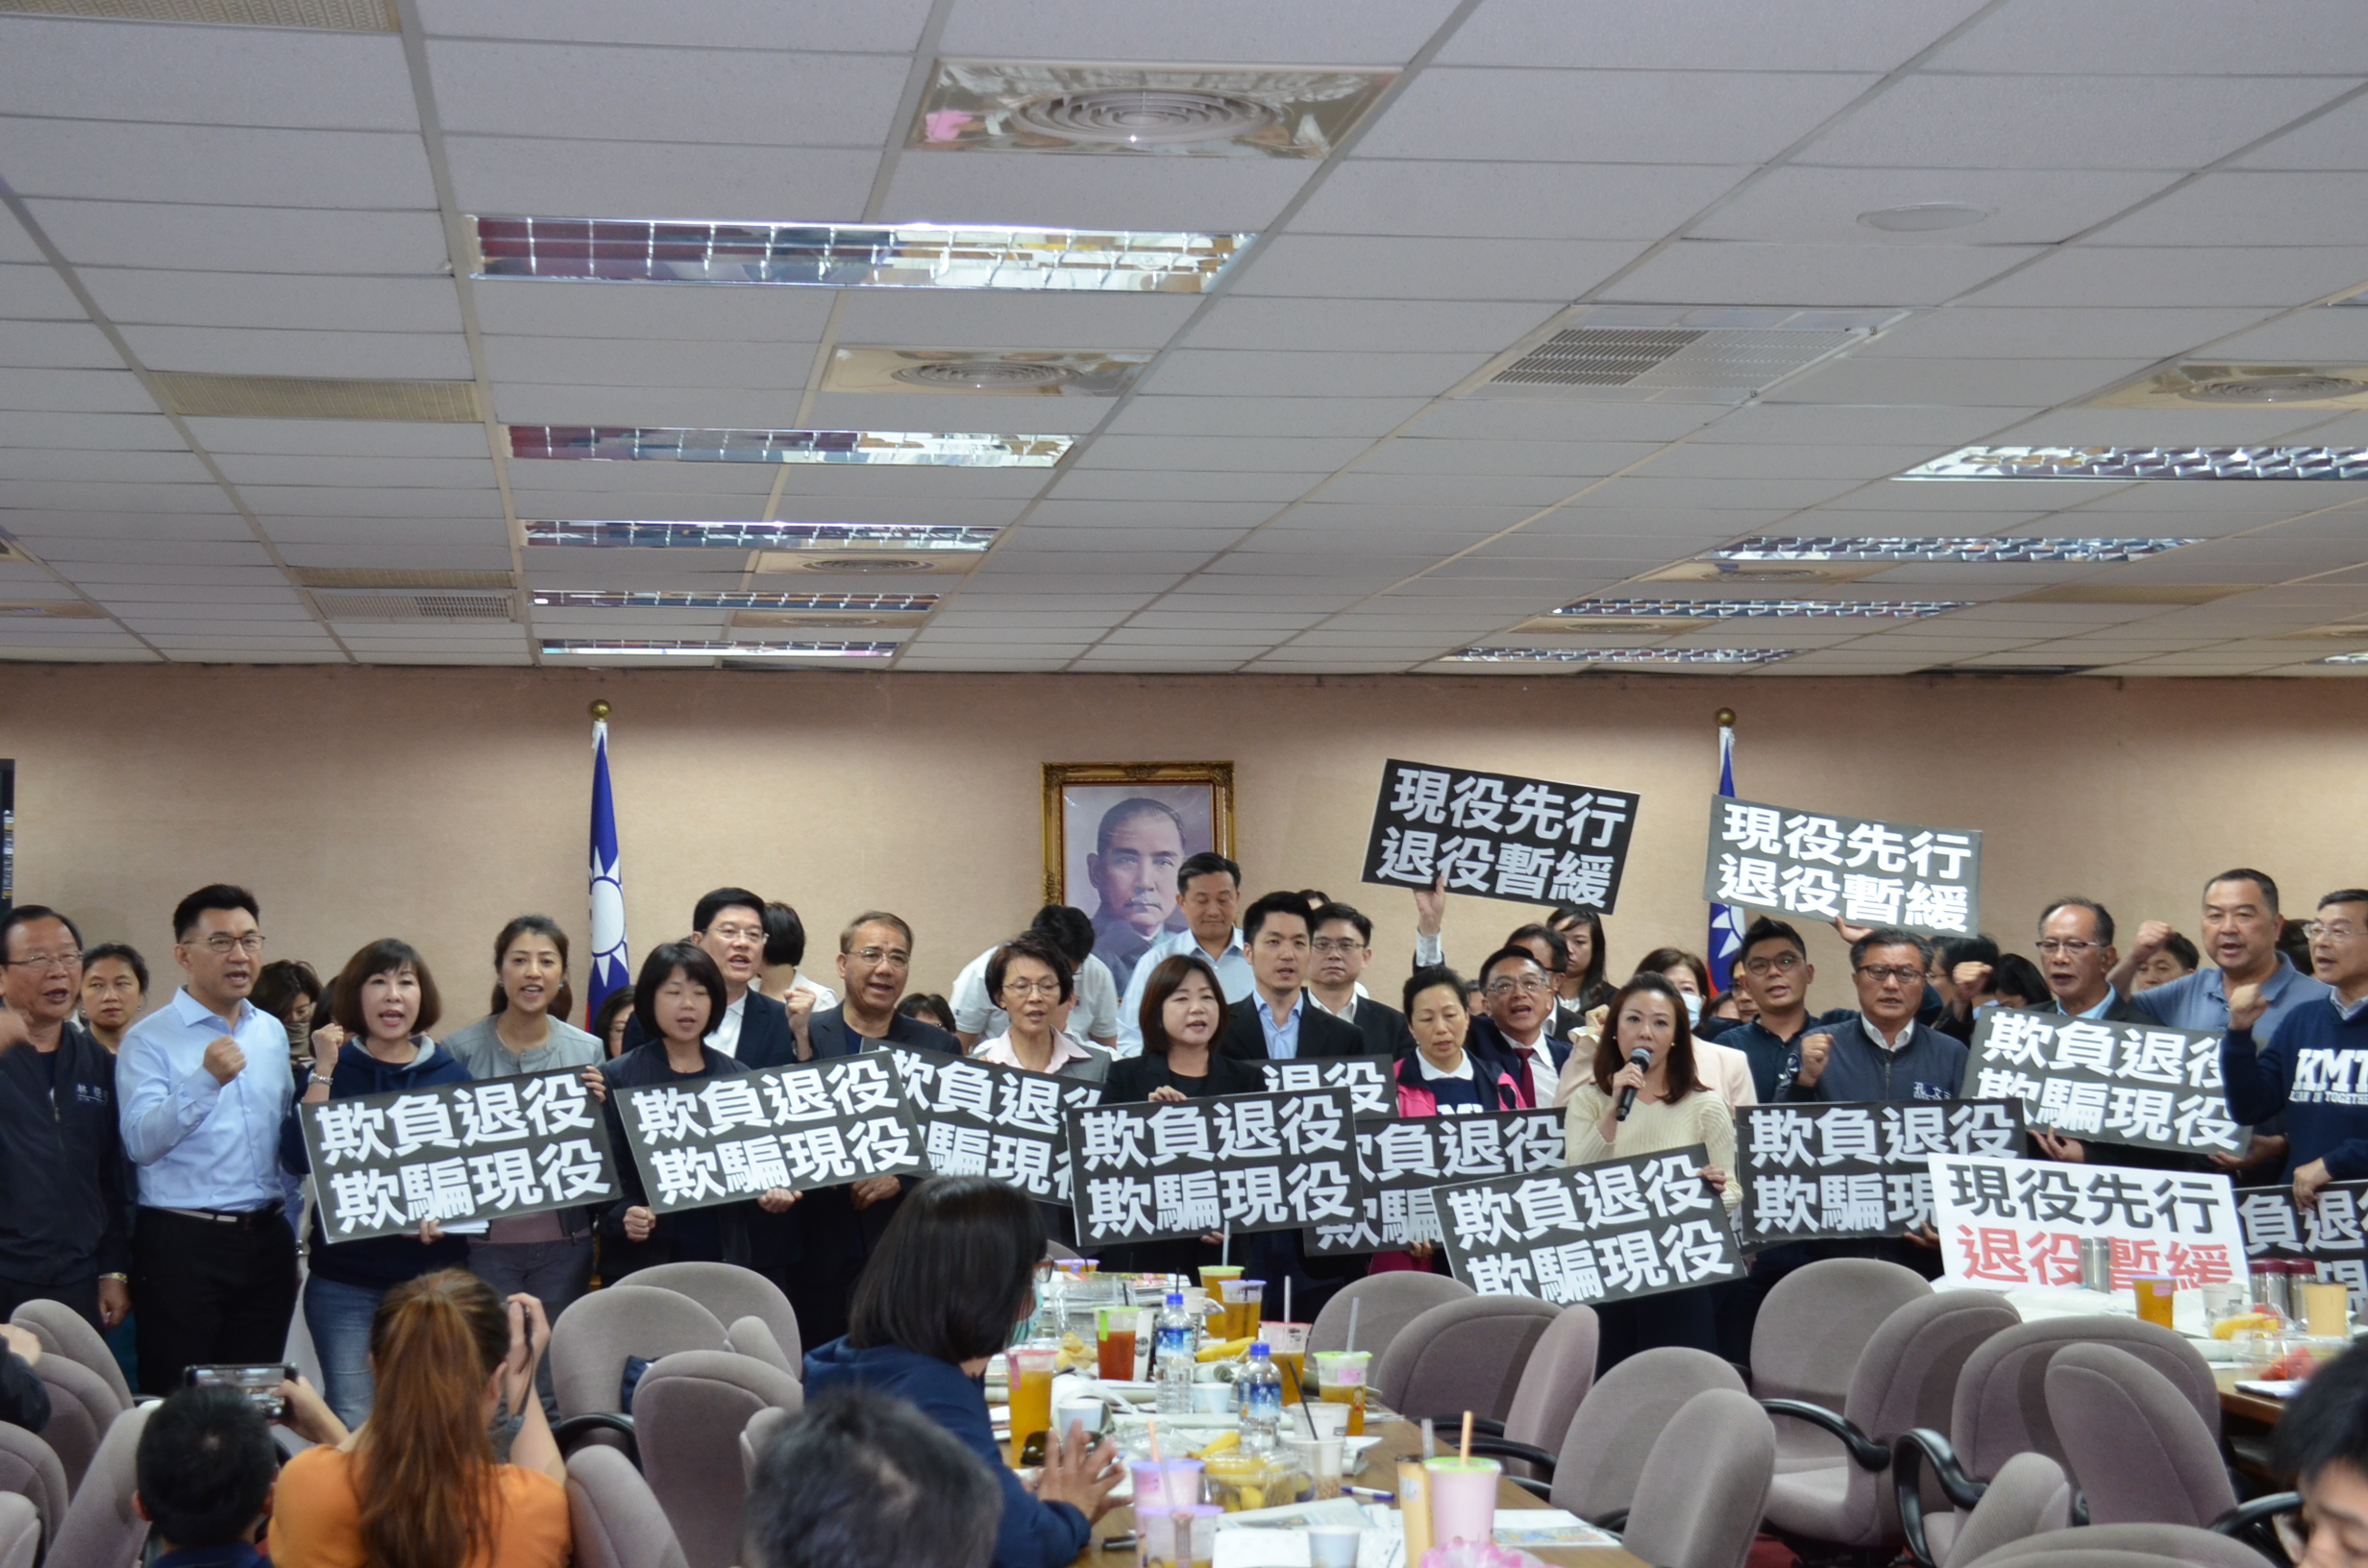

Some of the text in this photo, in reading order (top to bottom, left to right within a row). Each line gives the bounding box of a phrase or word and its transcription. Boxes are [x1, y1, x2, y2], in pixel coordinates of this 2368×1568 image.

[1389, 768, 1626, 847] 現役先行
[1722, 802, 1971, 879] 現役先行
[1376, 827, 1615, 909] 退役暫緩
[1716, 854, 1969, 934] 退役暫緩
[629, 1060, 899, 1146] 欺負退役
[2292, 1048, 2368, 1093] KMT
[315, 1073, 596, 1166] 欺負退役
[1080, 1095, 1347, 1172] 欺負退役
[1355, 1115, 1566, 1183] 負退役
[1749, 1105, 2017, 1169] 欺負退役
[330, 1139, 611, 1234] 欺騙現役
[650, 1116, 922, 1206] 欺騙現役
[1088, 1161, 1355, 1238] 欺騙現役
[1948, 1163, 2221, 1235] 現役先行
[1447, 1154, 1714, 1250] 欺負退役
[2237, 1189, 2368, 1256] 負退
[1466, 1218, 1736, 1304] 欺騙現役
[1956, 1224, 2234, 1292] 退役暫緩
